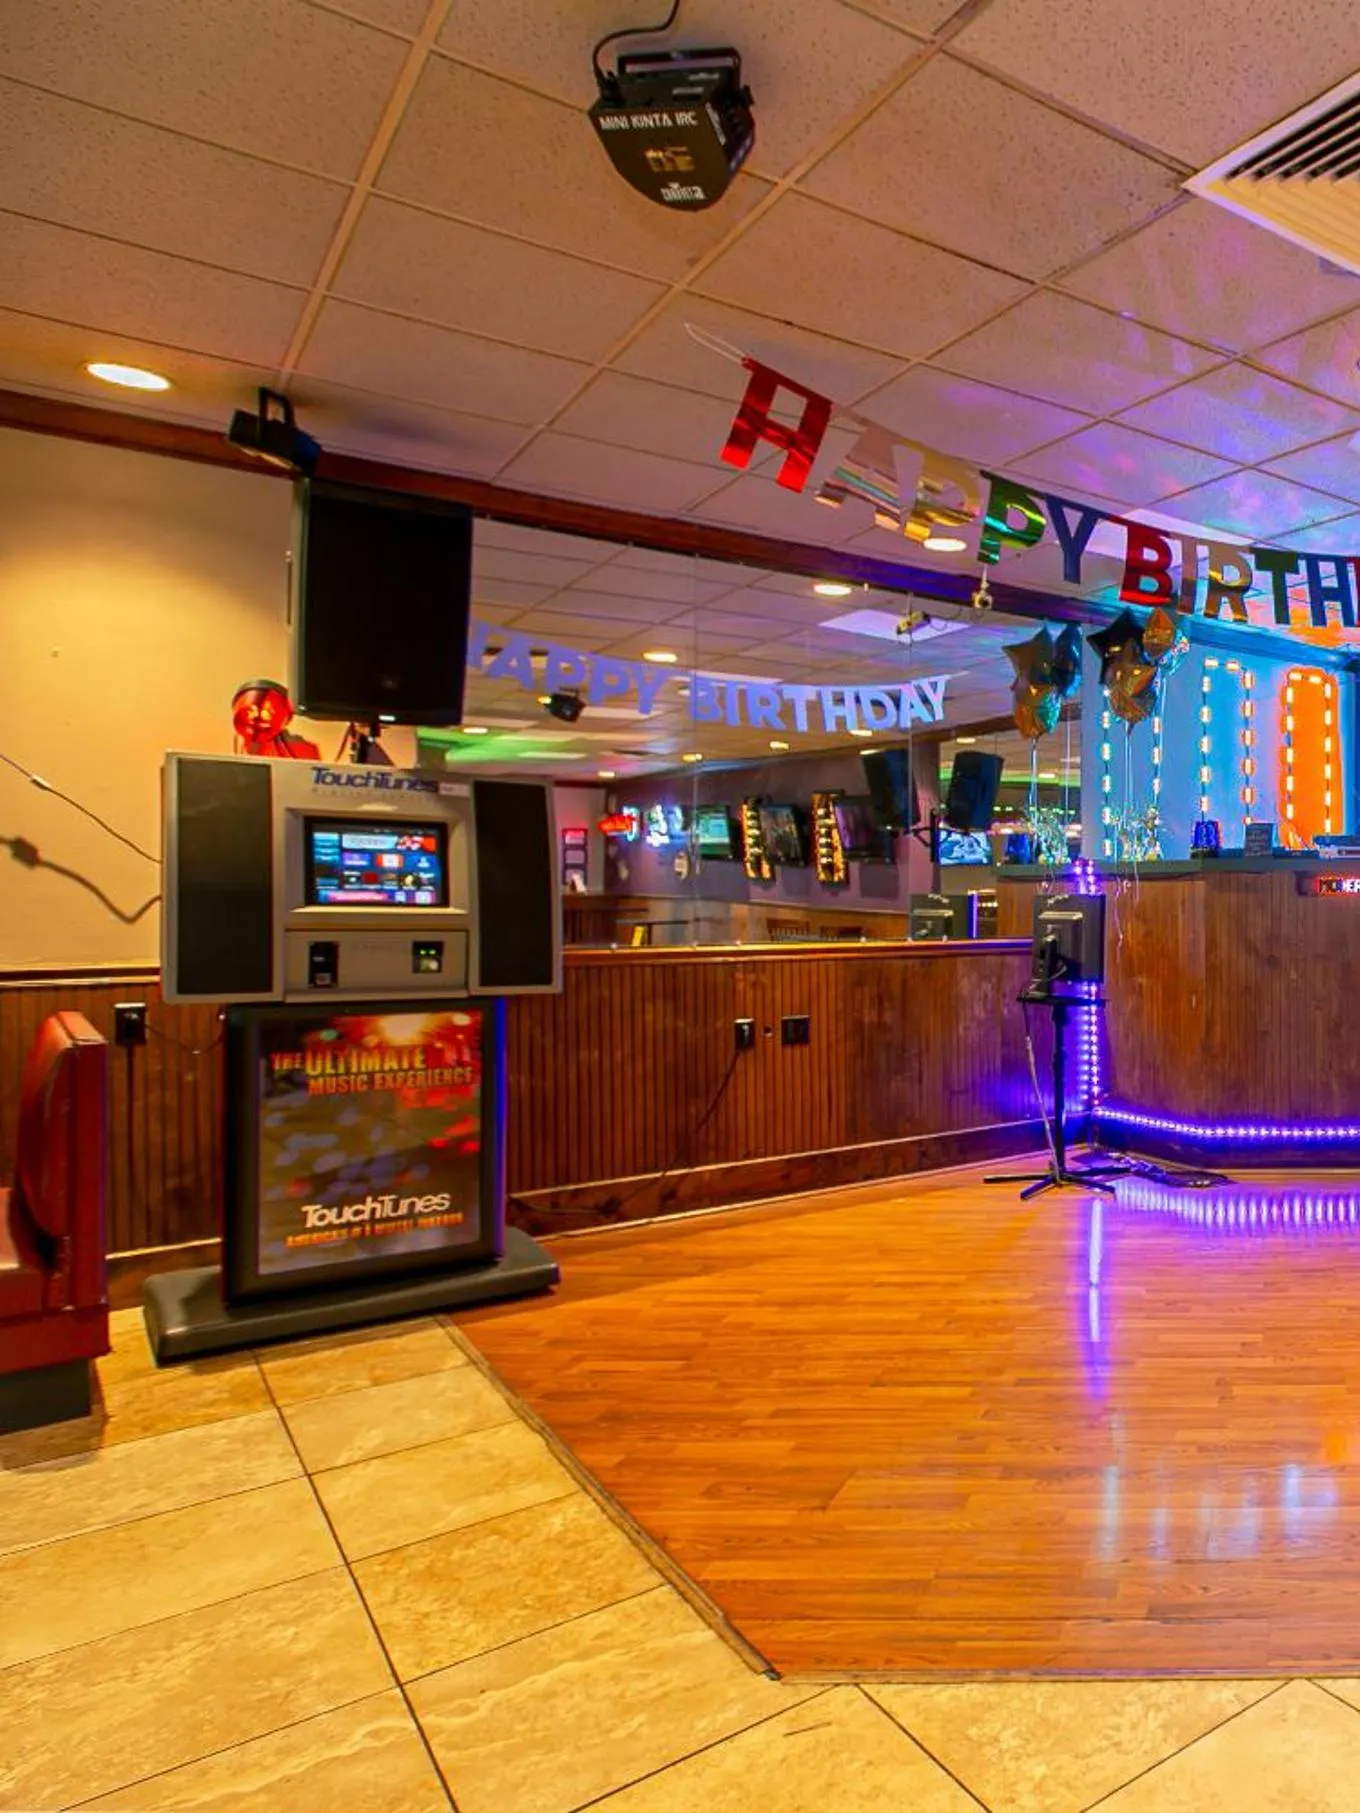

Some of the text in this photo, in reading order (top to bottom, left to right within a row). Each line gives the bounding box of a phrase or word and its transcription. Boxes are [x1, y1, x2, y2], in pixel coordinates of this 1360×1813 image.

[599, 110, 698, 129] MINI KINTA IRC
[720, 356, 1103, 584] HAPPY
[689, 672, 950, 733] BIRTHDAY
[271, 1046, 426, 1076] THE ULTIMATE
[308, 1066, 474, 1096] MUSIC EXPERIENCE
[301, 1193, 451, 1228] TouchTunes
